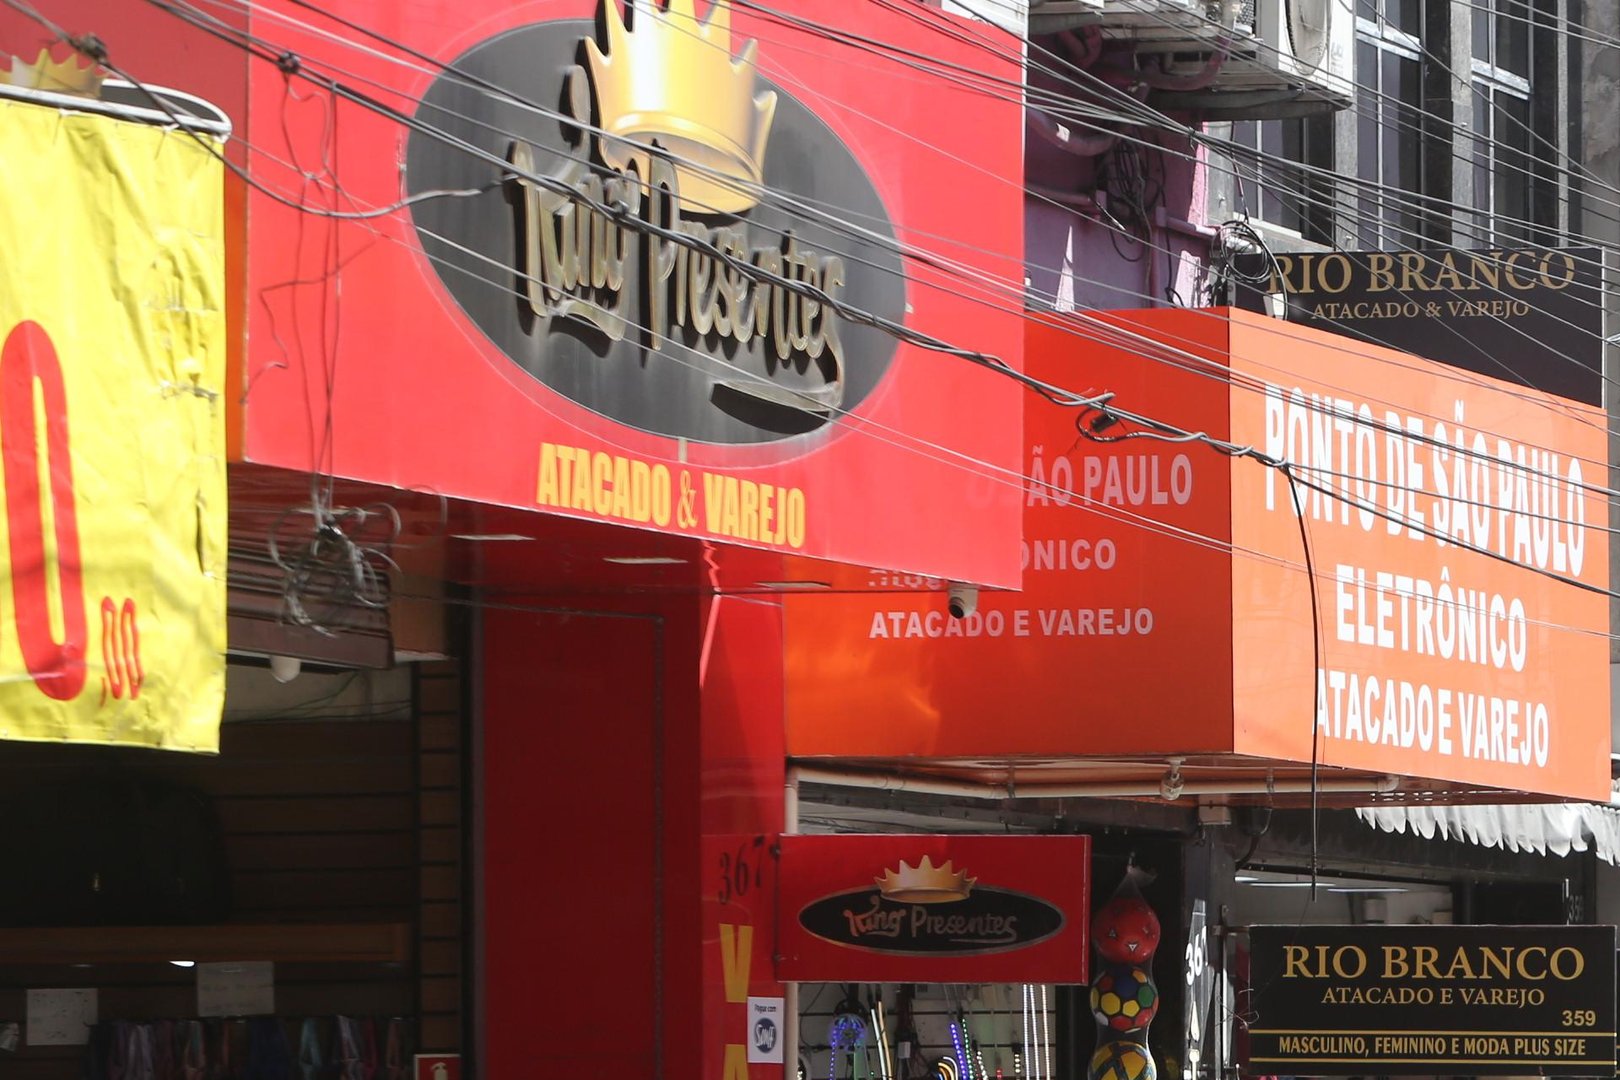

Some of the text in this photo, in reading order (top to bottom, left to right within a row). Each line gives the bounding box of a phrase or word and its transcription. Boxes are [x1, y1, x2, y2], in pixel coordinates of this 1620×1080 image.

[648, 151, 845, 411] Presentes
[1266, 251, 1576, 295] RIO BRANCO
[1311, 299, 1531, 320] ATACADO & VAREJO
[536, 442, 806, 548] ATACADO & VAREJO
[1084, 453, 1193, 506] PAULO
[1264, 383, 1585, 578] PONTO DE SÃO PAULO
[868, 607, 1154, 639] ATACADO E VAREJO
[1336, 563, 1528, 673] ELETRÔNICO
[1315, 667, 1549, 768] ATACADO E VAREJO
[718, 836, 765, 906] 367
[843, 896, 1018, 944] King Presentes
[1282, 945, 1586, 980] RIO BRANCO
[1321, 986, 1545, 1009] ATACADO E VAREJO
[1561, 1010, 1597, 1027] 359
[1278, 1036, 1586, 1057] MASCULINO, FEMININO E MODA PLUS SIZE
